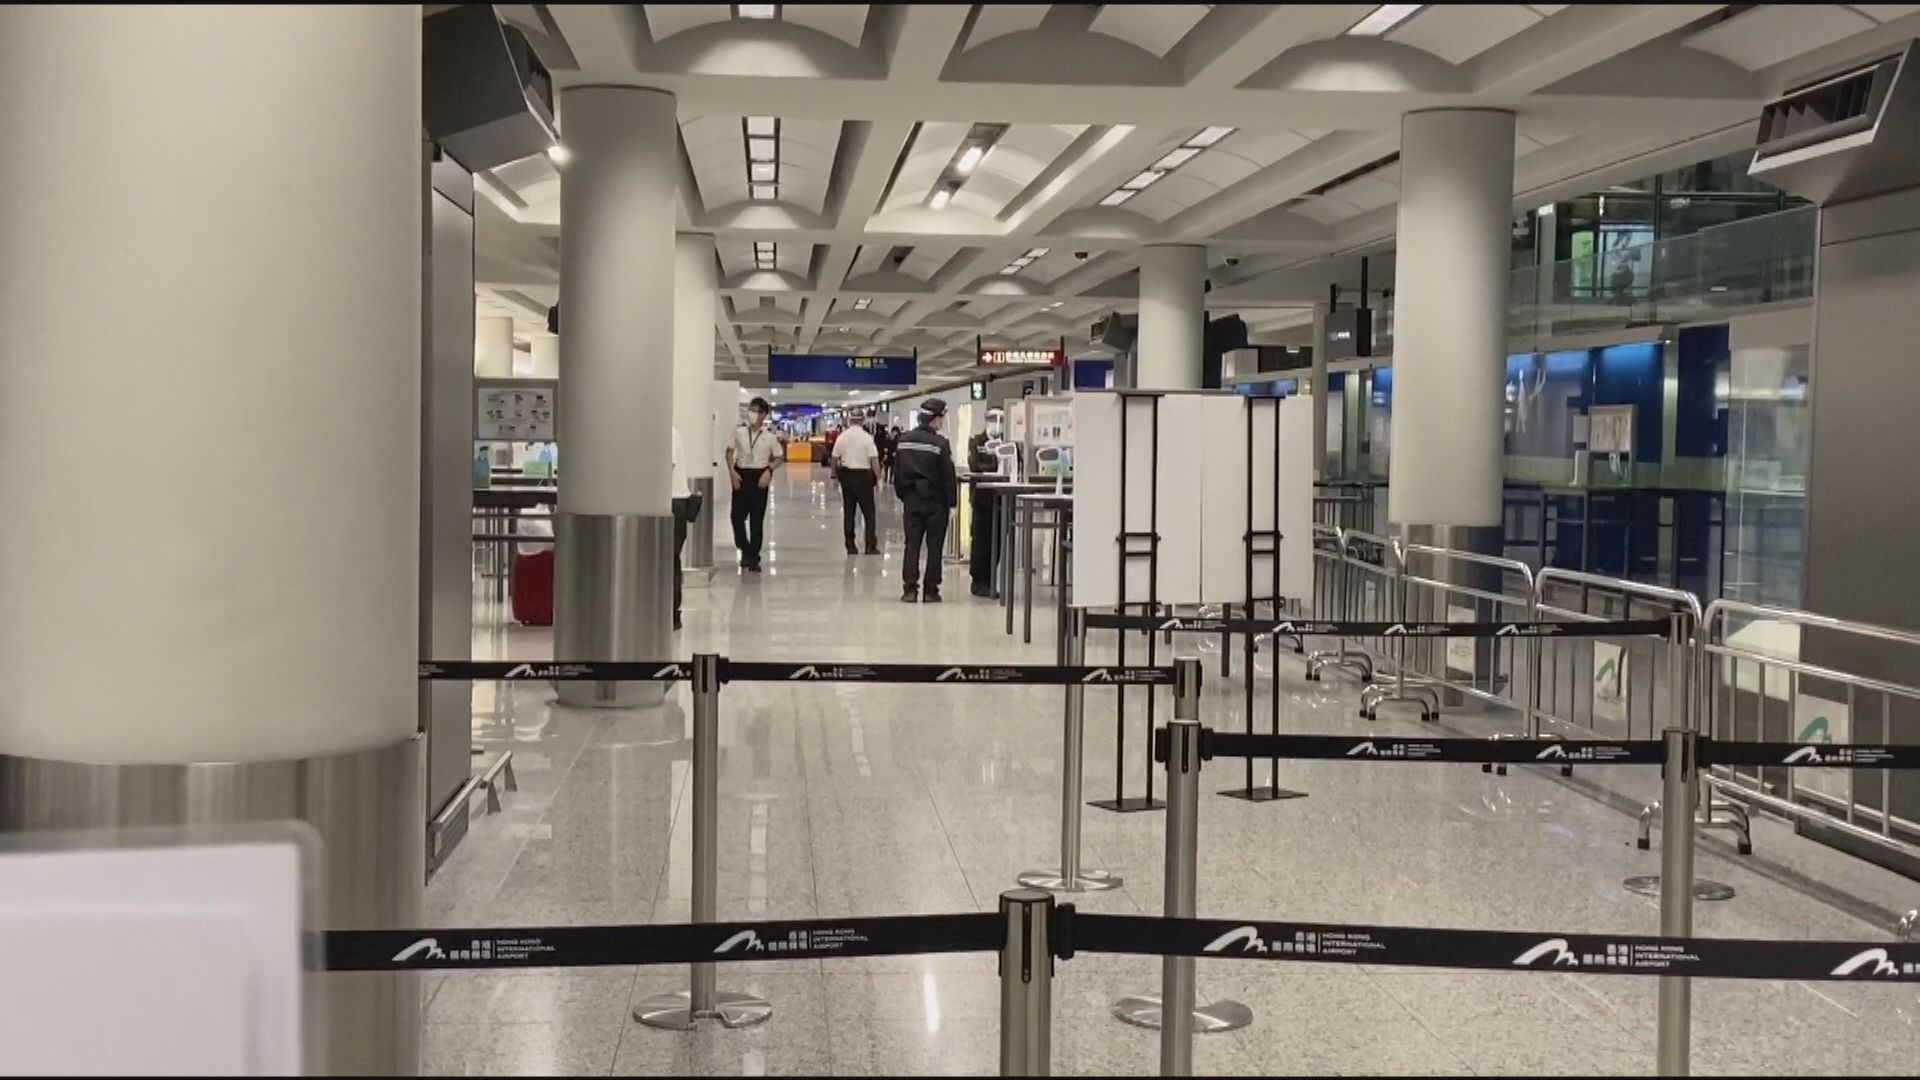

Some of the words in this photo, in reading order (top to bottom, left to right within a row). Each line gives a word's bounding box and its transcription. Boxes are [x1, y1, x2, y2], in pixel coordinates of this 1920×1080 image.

[1322, 940, 1386, 949] INTERNATIONAL
[1660, 945, 1684, 953] KONG
[1635, 952, 1700, 961] INTERNATIONAL
